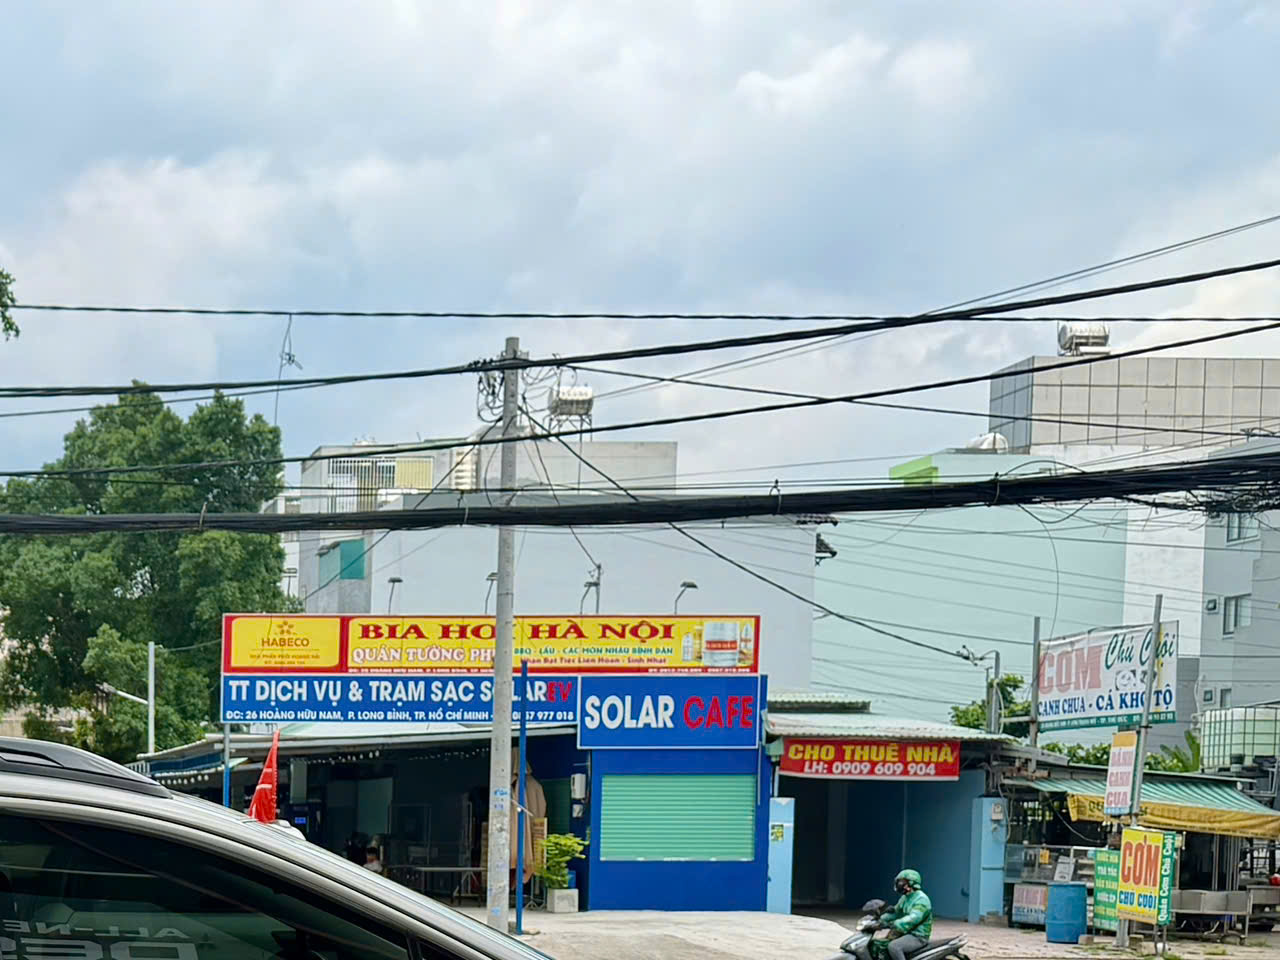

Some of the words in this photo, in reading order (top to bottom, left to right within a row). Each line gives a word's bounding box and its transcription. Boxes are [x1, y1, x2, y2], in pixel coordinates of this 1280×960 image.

[358, 624, 429, 639] BIA
[528, 619, 588, 640] HÀ
[598, 620, 675, 643] NỘI
[261, 638, 310, 647] HABECO
[352, 645, 401, 663] QUÁN
[228, 680, 250, 701] TT
[255, 680, 307, 706] DỊCH
[314, 680, 342, 706] VỤ
[348, 680, 363, 702] &
[369, 680, 425, 707] TRẠM
[431, 680, 475, 707] SẠC
[1095, 689, 1114, 711] CÁ
[1153, 684, 1173, 710] TỘ
[225, 710, 244, 720] ĐC:
[245, 710, 258, 720] 26
[260, 708, 295, 720] HOÀNG
[319, 710, 344, 721] NAM,
[358, 711, 385, 720] LONG
[387, 708, 412, 721] BÌNH,
[445, 708, 463, 720] CHÍ
[464, 711, 489, 720] MINH
[537, 711, 553, 720] 977
[556, 711, 574, 720] 018
[584, 695, 675, 729] SOLAR
[683, 695, 754, 730] CAFE
[788, 743, 835, 761] CHO
[842, 743, 899, 762] THUÊ
[906, 743, 954, 763] NHÀ
[803, 761, 827, 774] LH:
[832, 762, 870, 775] 0909
[874, 763, 904, 775] 609
[907, 763, 936, 776] 904
[1106, 791, 1128, 806] CUA
[1121, 834, 1161, 887] CƠM
